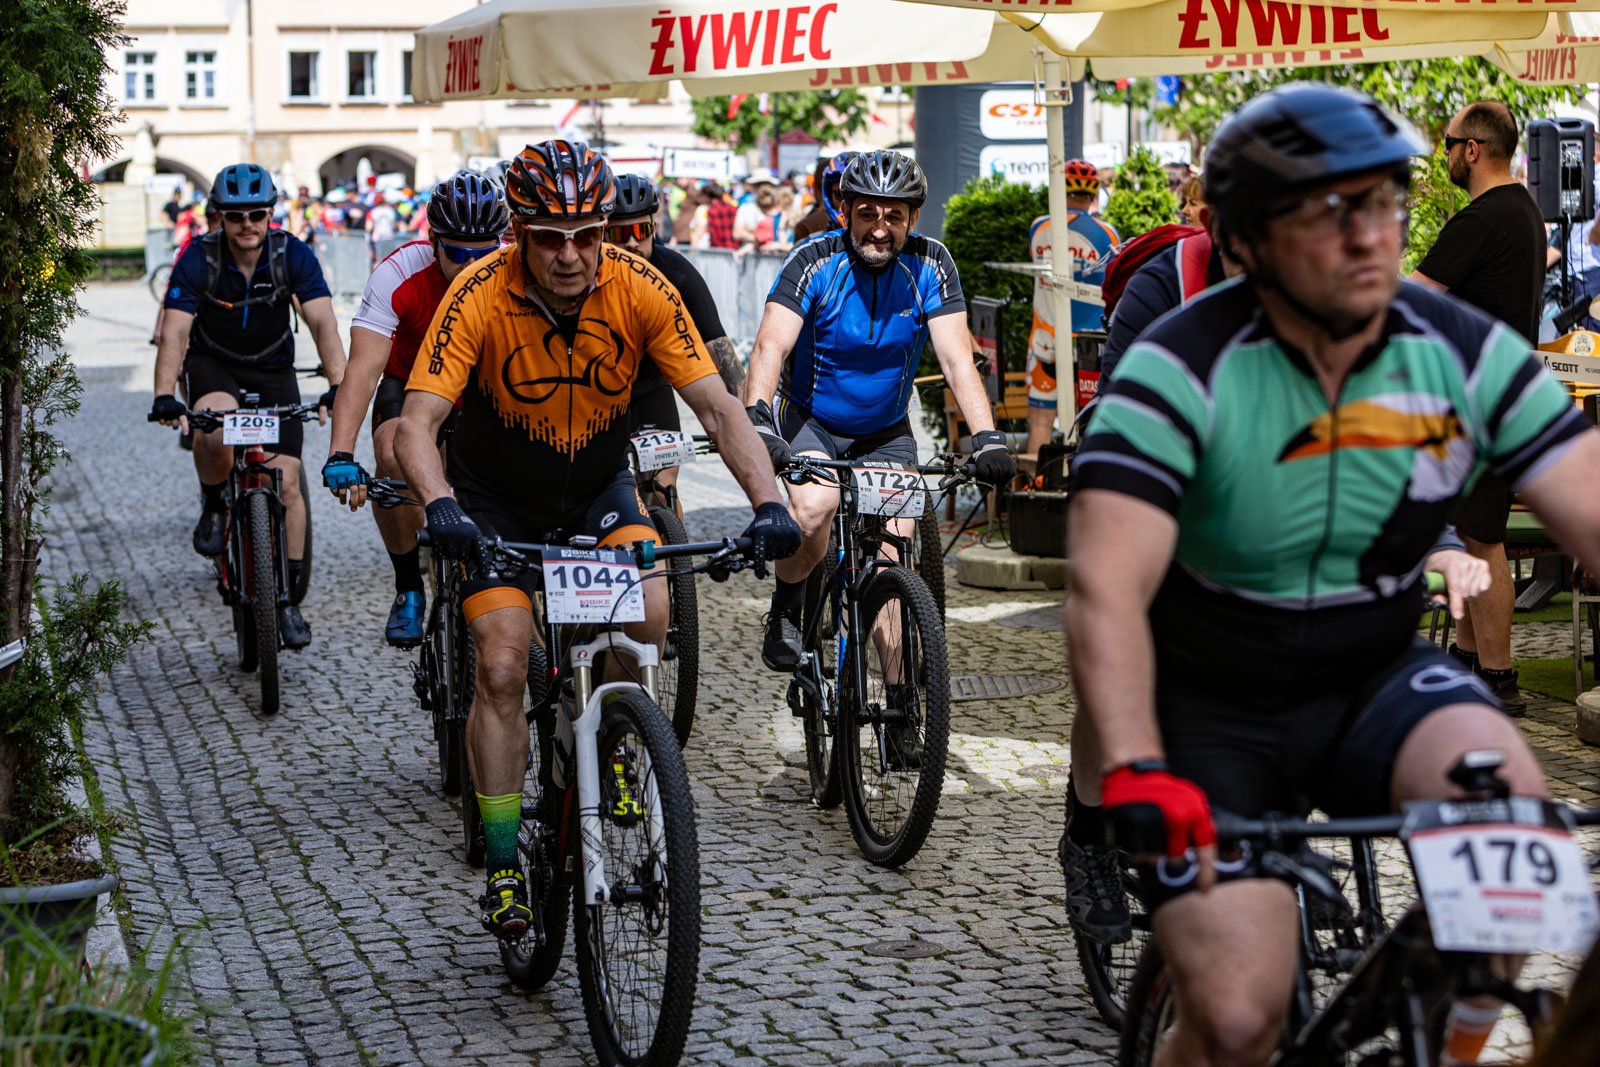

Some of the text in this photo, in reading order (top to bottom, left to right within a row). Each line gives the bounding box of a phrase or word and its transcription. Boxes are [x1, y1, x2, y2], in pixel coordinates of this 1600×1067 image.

[648, 3, 838, 75] ŻYWIEC
[444, 34, 483, 93] ŻYWIEC
[606, 248, 701, 361] SPORT-PROFIT
[1552, 362, 1578, 373] SCOTT
[229, 416, 275, 428] 1205
[861, 471, 919, 489] 1722
[552, 565, 635, 589] 1044
[1453, 839, 1558, 886] 179
